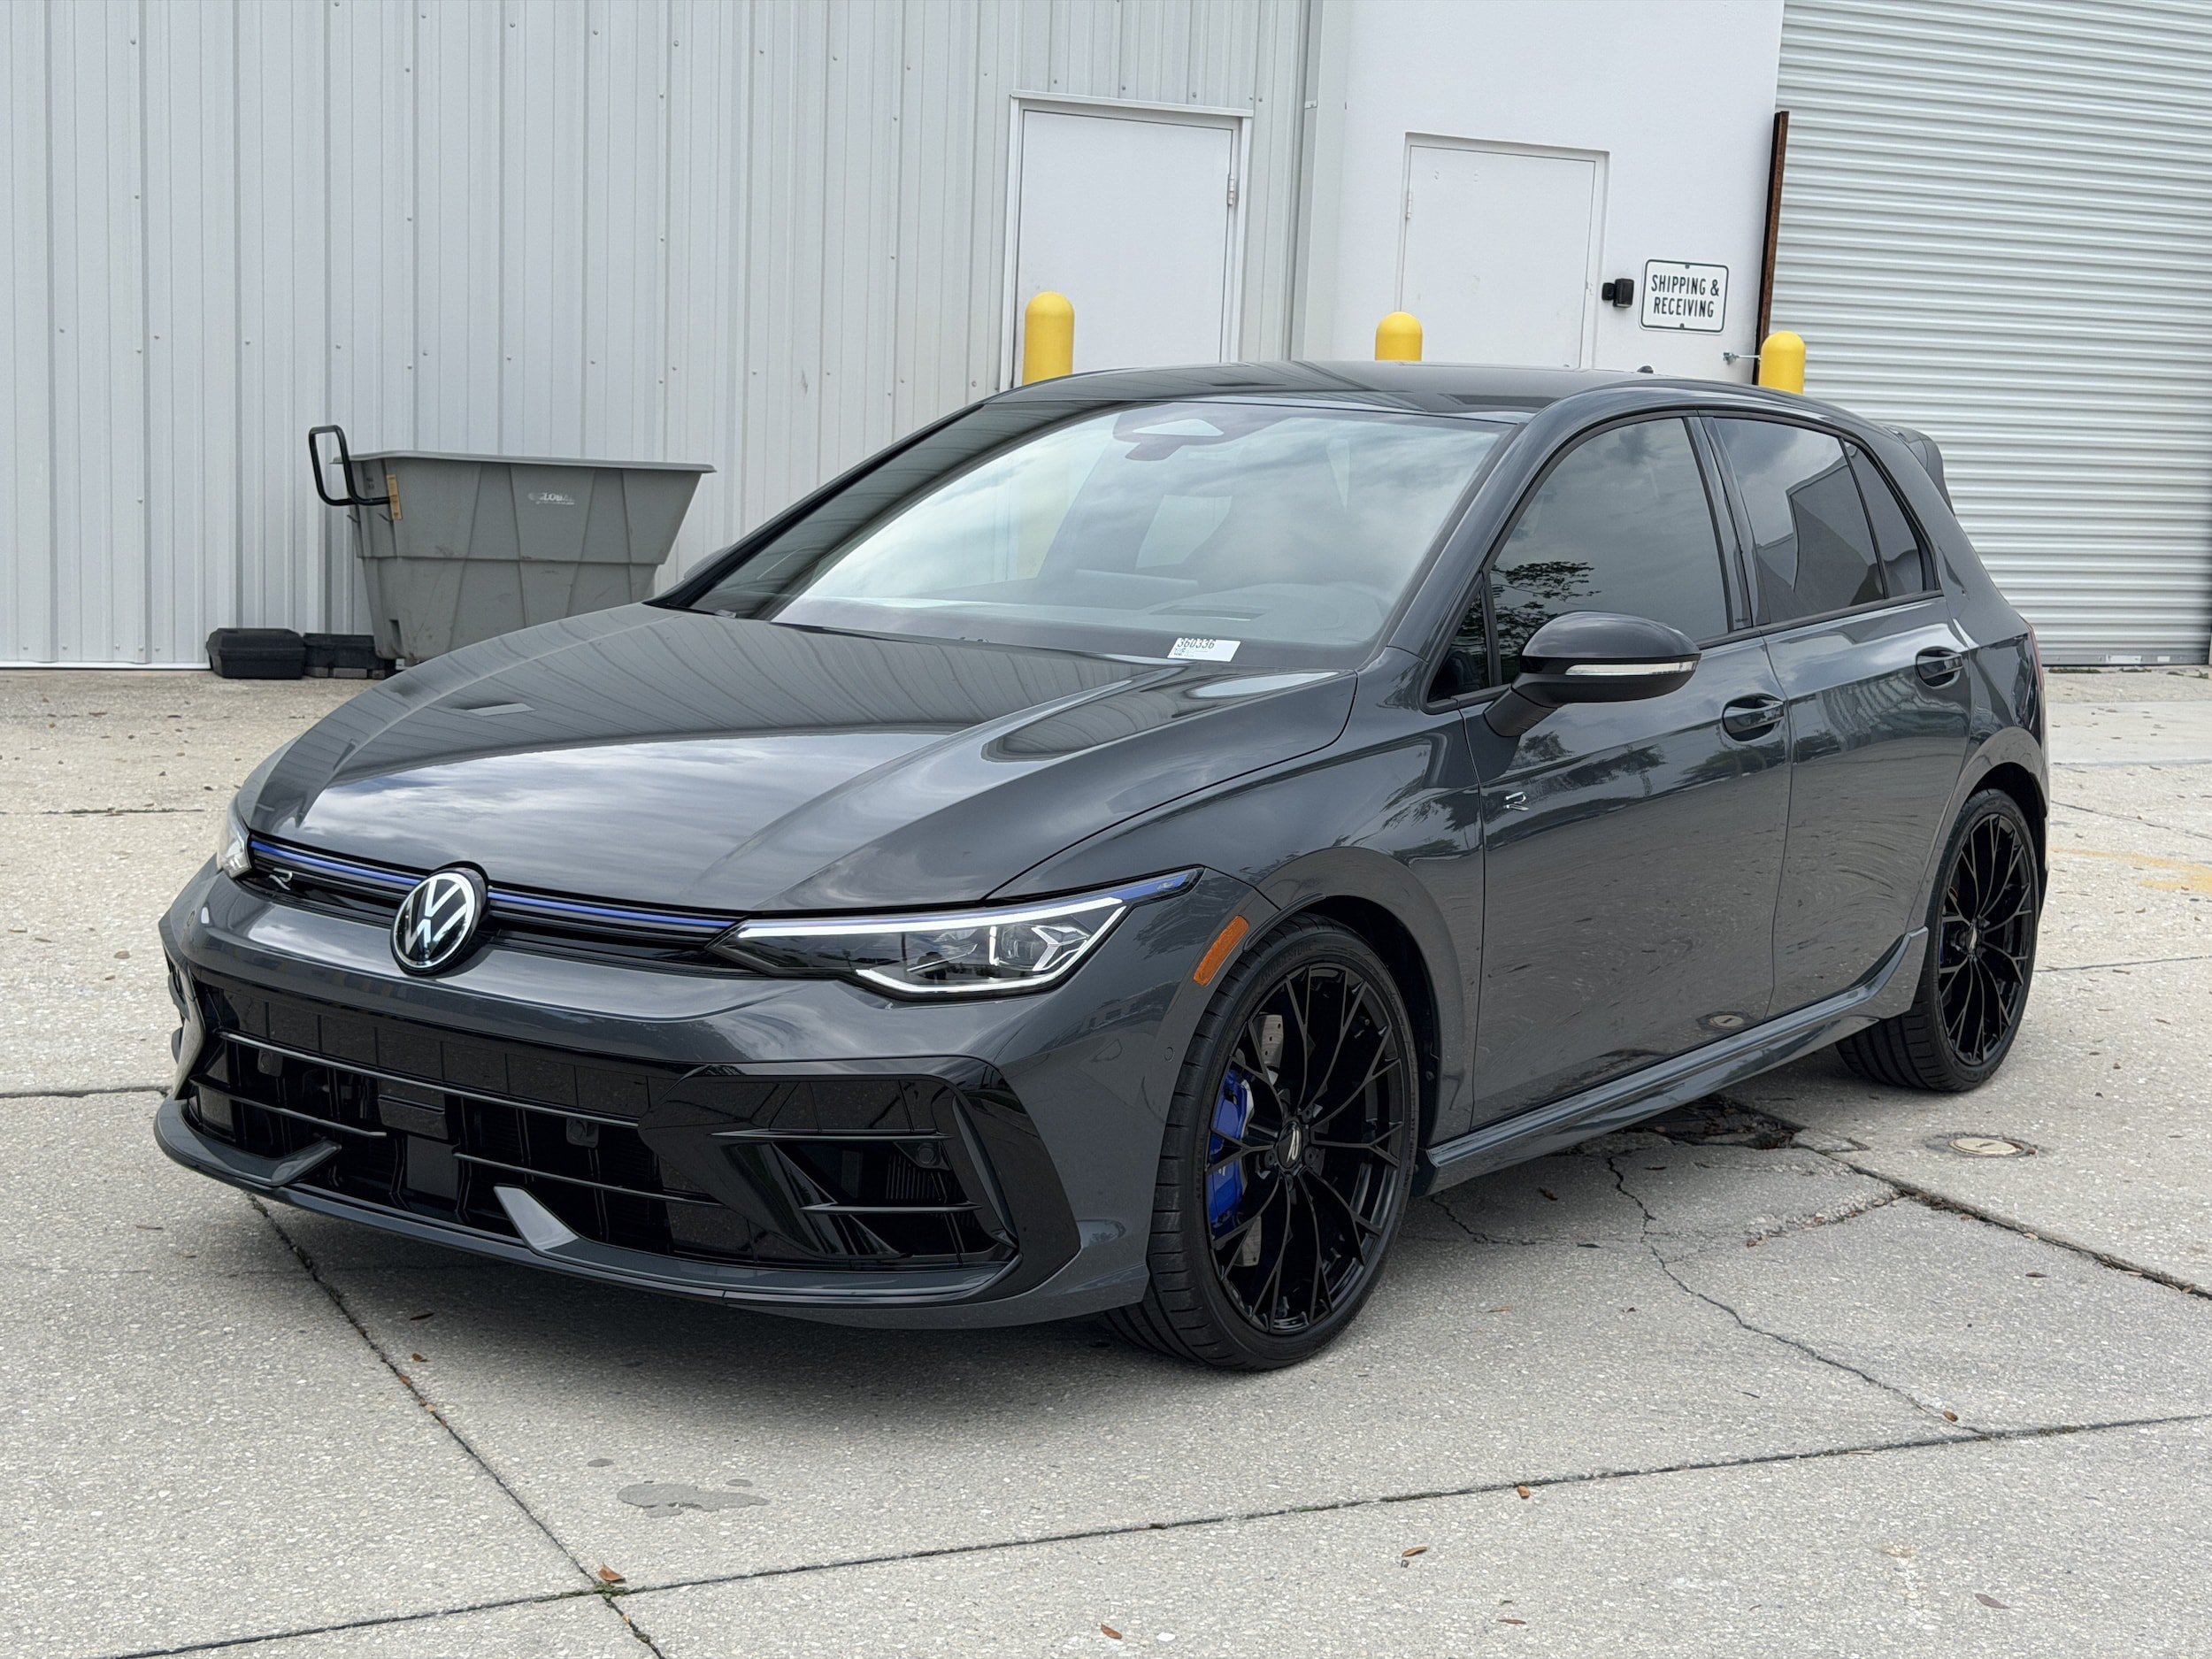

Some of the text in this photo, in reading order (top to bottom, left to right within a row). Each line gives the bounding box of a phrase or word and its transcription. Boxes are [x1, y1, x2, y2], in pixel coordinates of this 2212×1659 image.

[1651, 274, 1720, 296] SHIPPING &
[1653, 296, 1715, 319] RECEIVING
